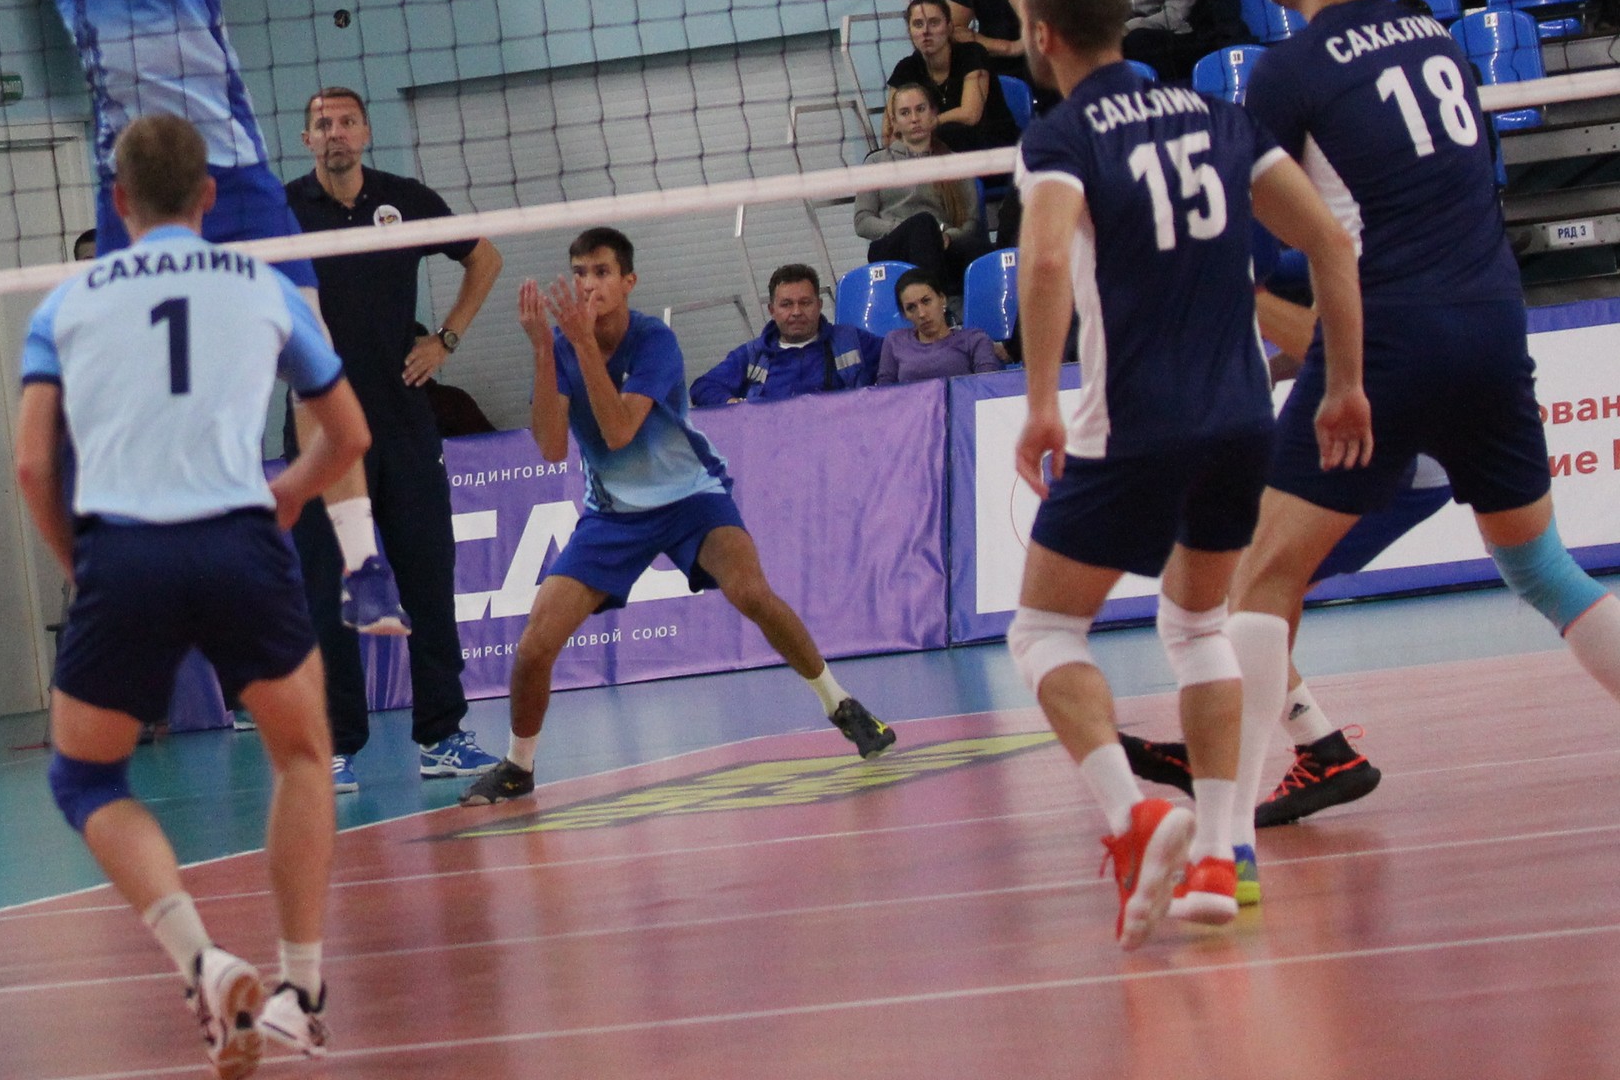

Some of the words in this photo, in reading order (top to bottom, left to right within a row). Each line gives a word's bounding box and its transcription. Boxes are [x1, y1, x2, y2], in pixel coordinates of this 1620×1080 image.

[1375, 54, 1478, 158] 18
[1128, 129, 1228, 252] 15
[1558, 226, 1578, 239] РЯД
[1580, 224, 1587, 236] 3
[87, 251, 256, 289] САХАЛИН
[150, 296, 191, 396] 1
[447, 461, 568, 487] ОЛДИНГОВАЯ
[461, 642, 519, 660] БИРСК
[562, 627, 622, 649] ЛОВОЙ
[632, 625, 678, 640] СОЮЗ
